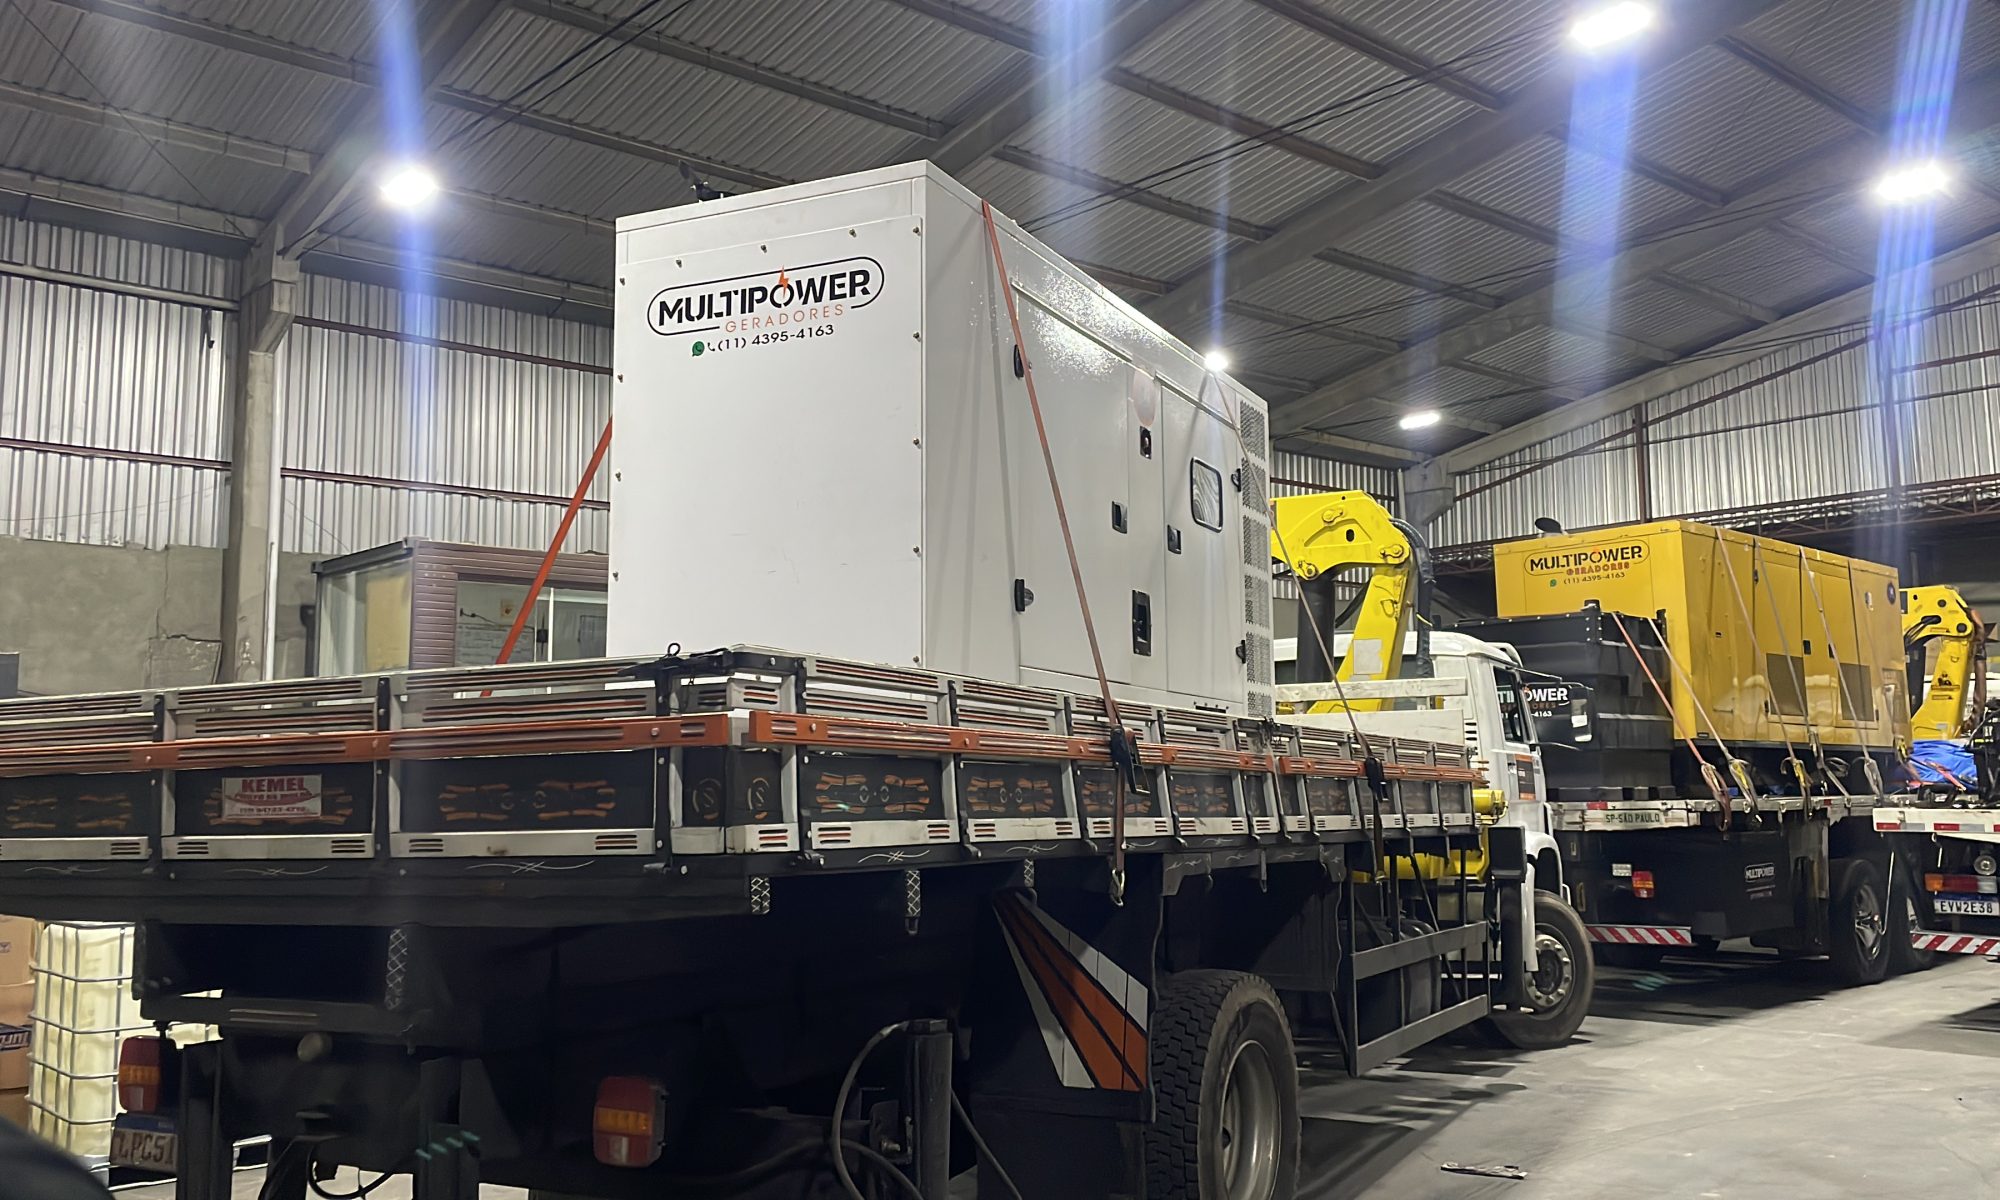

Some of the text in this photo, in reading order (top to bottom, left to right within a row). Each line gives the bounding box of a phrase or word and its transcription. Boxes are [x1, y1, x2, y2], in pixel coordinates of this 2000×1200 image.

[658, 269, 871, 326] MULTIPOWER
[725, 304, 844, 333] GERADORES
[717, 324, 834, 352] (11) 4395-4163
[1530, 546, 1642, 571] MULTIPOWER
[1566, 562, 1630, 576] GERADORES
[1582, 572, 1625, 582] 4395-4163
[241, 777, 304, 792] KEMEL
[1635, 813, 1660, 823] PAULO
[1940, 901, 1993, 914] EYW2E38
